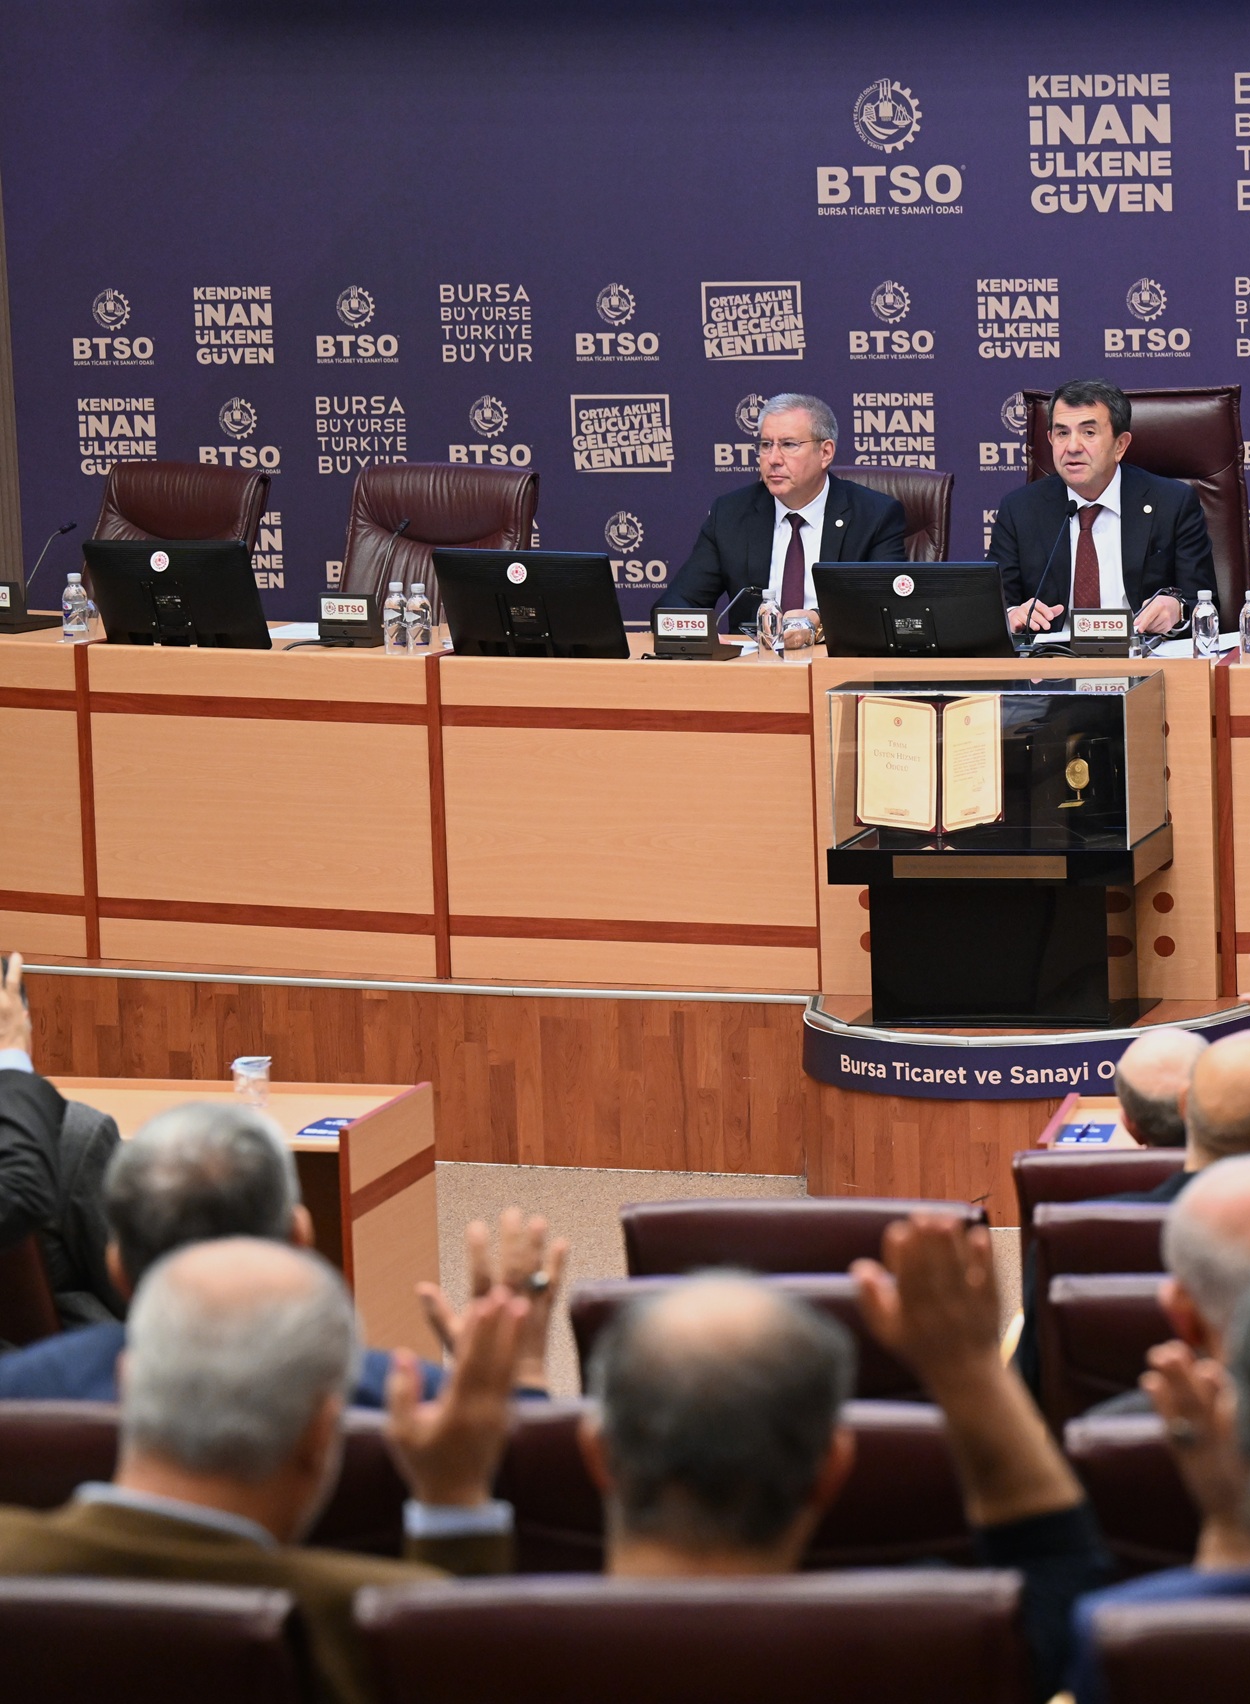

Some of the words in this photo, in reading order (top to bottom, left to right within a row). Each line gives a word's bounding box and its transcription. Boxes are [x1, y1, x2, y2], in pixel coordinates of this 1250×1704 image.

[1028, 74, 1170, 98] KENDİNE
[1029, 104, 1171, 145] İNAN
[1030, 151, 1172, 178] ÜLKENE
[817, 165, 962, 204] BTSO
[1031, 183, 1172, 213] GÜVEN
[818, 205, 847, 215] BURSA
[850, 205, 885, 215] TİCARET
[889, 205, 899, 215] VE
[902, 205, 933, 215] SANAYİ
[936, 205, 963, 215] ODASI
[194, 287, 271, 300] KENDİNE
[440, 284, 529, 302] BURSA
[977, 278, 1058, 292] KENDİNE
[710, 294, 751, 307] ORTAK
[754, 289, 791, 303] AKLIN
[978, 296, 1059, 319] İNAN
[195, 303, 272, 326] İNAN
[441, 307, 531, 321] BÜYÜRSE
[711, 300, 793, 322] GÜCÜYLE
[196, 330, 273, 344] ÜLKENE
[442, 325, 531, 340] TÜRKİYE
[703, 314, 803, 339] GELECEĞİN
[978, 323, 1059, 338] ÜLKENE
[73, 337, 153, 359] BTSO
[316, 335, 398, 357] BTSO
[576, 332, 658, 355] BTSO
[704, 329, 806, 358] KENTİNE
[849, 330, 932, 353] BTSO
[979, 341, 1060, 358] GÜVEN
[1105, 328, 1190, 351] BTSO
[197, 348, 274, 364] GÜVEN
[443, 344, 532, 362] BÜYÜR
[78, 398, 154, 411] KENDİNE
[316, 396, 404, 414] BURSA
[853, 393, 933, 406] KENDİNE
[579, 406, 620, 420] ORTAK
[623, 402, 660, 416] AKLIN
[854, 410, 934, 433] İNAN
[79, 415, 155, 437] İNAN
[317, 419, 406, 432] BÜYÜRSE
[581, 413, 662, 434] GÜCÜYLE
[80, 441, 156, 455] ÜLKENE
[318, 437, 406, 451] TÜRKİYE
[573, 426, 672, 451] GELECEĞİN
[854, 437, 935, 451] ÜLKENE
[199, 446, 280, 468] BTSO
[449, 444, 531, 466] BTSO
[573, 442, 674, 470] KENTİNE
[610, 560, 666, 582] TSO
[338, 605, 364, 613] BTSO
[677, 620, 705, 629] BTSO
[1093, 621, 1123, 629] BTSO
[840, 1054, 887, 1079] Bursa
[892, 1061, 967, 1084] Ticaret
[974, 1070, 1002, 1085] ve
[1010, 1061, 1089, 1085] Sanayi
